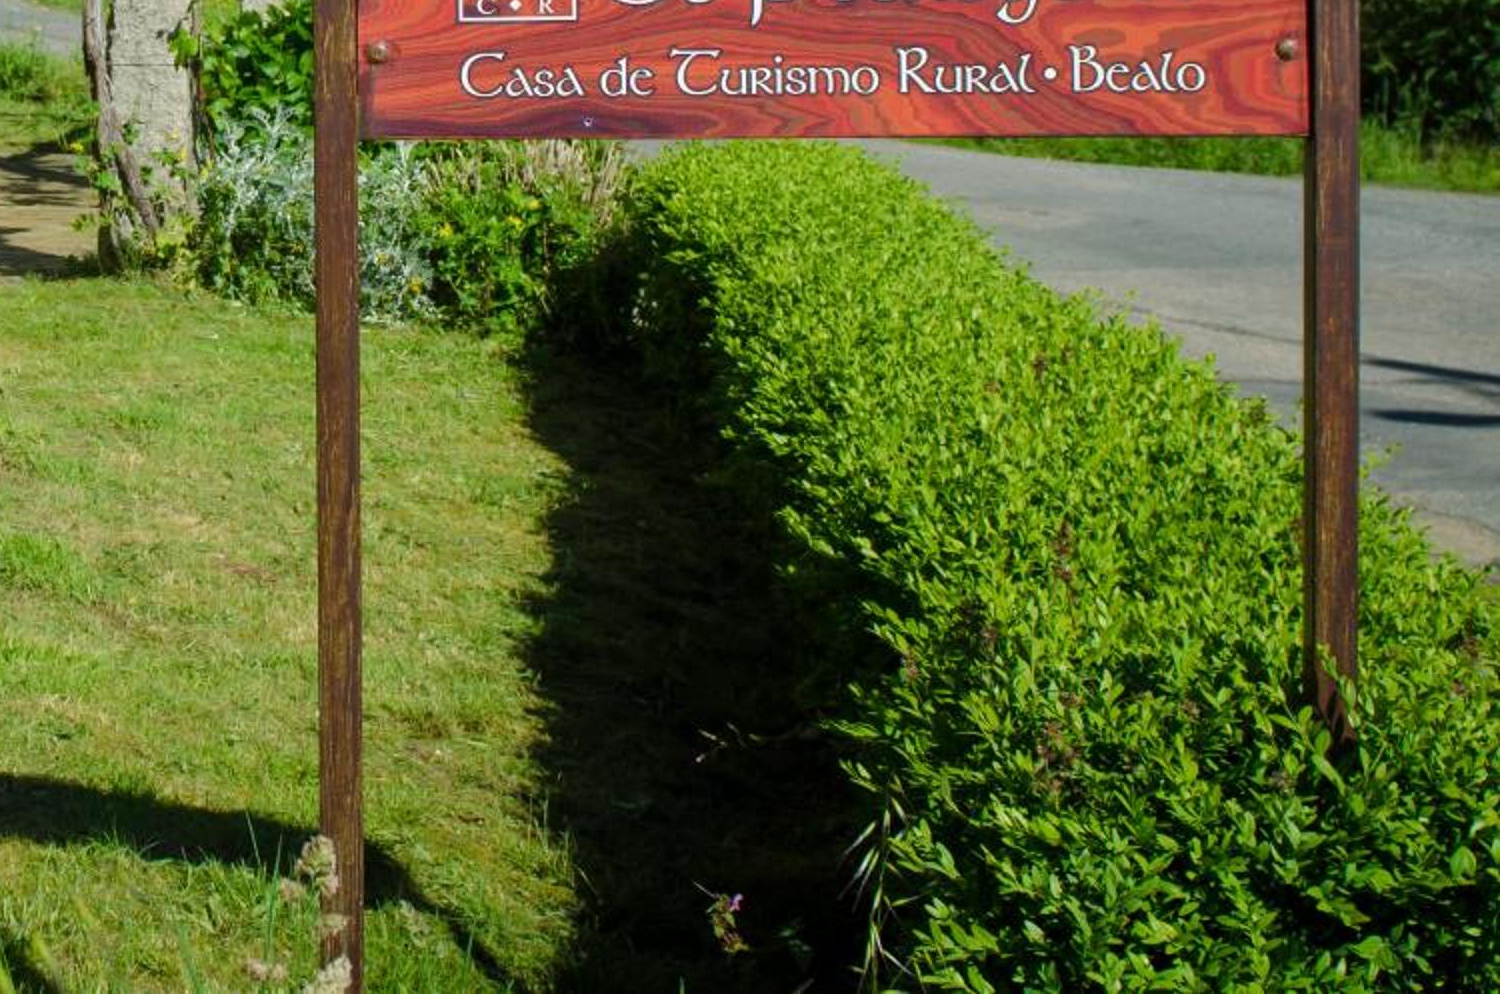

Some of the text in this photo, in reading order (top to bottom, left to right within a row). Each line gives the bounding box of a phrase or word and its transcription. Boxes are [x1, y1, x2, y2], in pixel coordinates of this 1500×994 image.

[460, 45, 1206, 97] Casa de Turismo Rural Bealo
